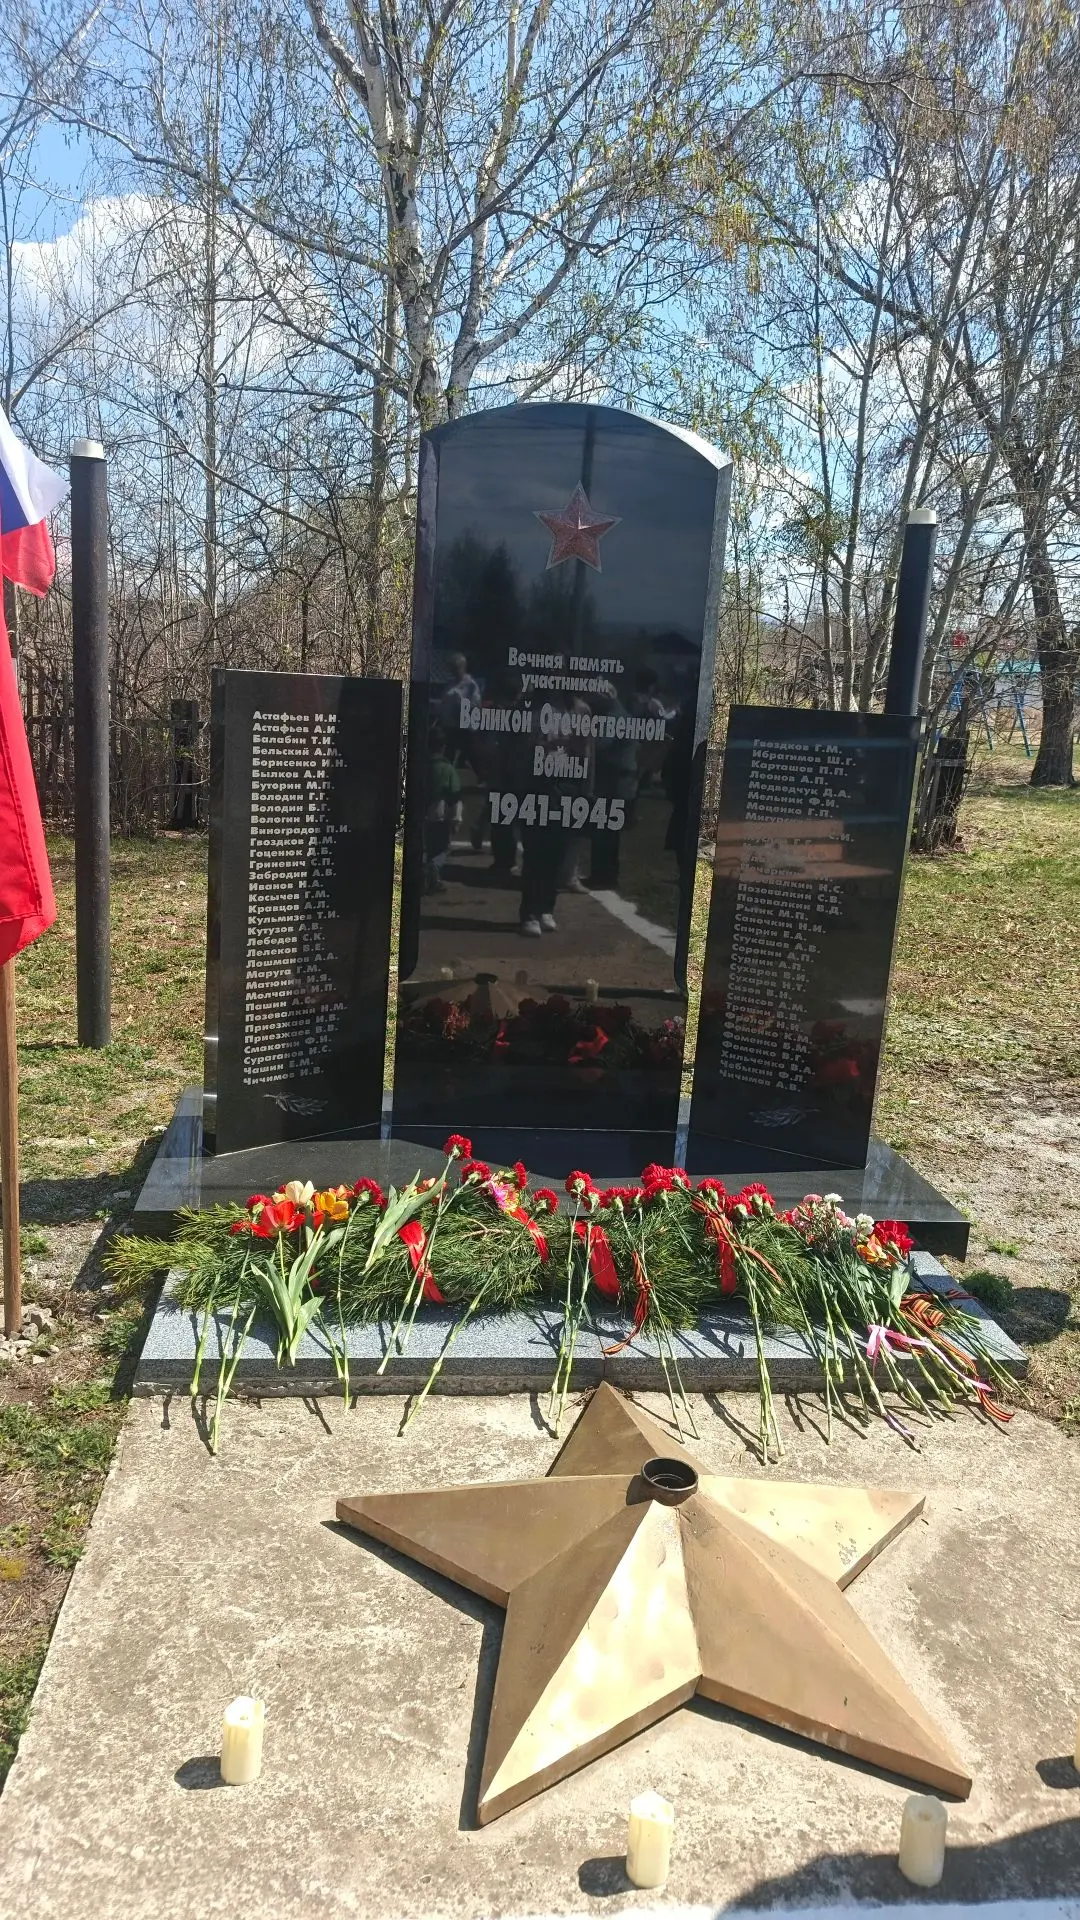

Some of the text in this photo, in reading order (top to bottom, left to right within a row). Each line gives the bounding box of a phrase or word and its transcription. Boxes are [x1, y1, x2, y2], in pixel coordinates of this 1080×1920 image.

[508, 647, 625, 673] Вечная память
[521, 673, 609, 693] участникам
[253, 711, 340, 723] Астафьев И.Н.
[460, 697, 666, 741] Великой Отечественной
[253, 723, 340, 734] Астафьев А.И.
[253, 735, 335, 745] Балабин Т.И.
[253, 746, 342, 756] Бельский А.М.
[753, 750, 821, 763] Ибрагимов
[253, 758, 347, 768] Борисенко И.Н.
[533, 746, 588, 779] Войны
[252, 770, 329, 778] Былков А.Н.
[252, 781, 335, 791] Буторин М.П.
[251, 792, 329, 801] Володин Г.Г.
[251, 804, 303, 813] Володин
[489, 792, 625, 831] 1941-1945
[251, 815, 300, 823] Вологин
[250, 825, 351, 835] Виноградов П.И.
[250, 836, 337, 846] Гвоздков Д.М.
[250, 850, 302, 858] Гоценюк
[249, 858, 334, 870] Гриневич С.П.
[249, 871, 307, 880] Забродин
[249, 880, 323, 891] Иванов Н.А.
[305, 890, 330, 899] Г.М.
[249, 904, 299, 914] Кравцов
[248, 915, 312, 925] Кульмизев
[248, 927, 294, 936] Кутузов
[247, 936, 297, 946] Лебедев
[246, 948, 297, 957] Лелеков
[246, 953, 338, 968] Лошманов А.А.
[246, 969, 291, 979] Маруга
[246, 988, 305, 1000] Молчанов
[246, 1002, 287, 1011] Пашин
[245, 1019, 310, 1033] Приезжаев
[245, 1030, 310, 1043] Приезжаев
